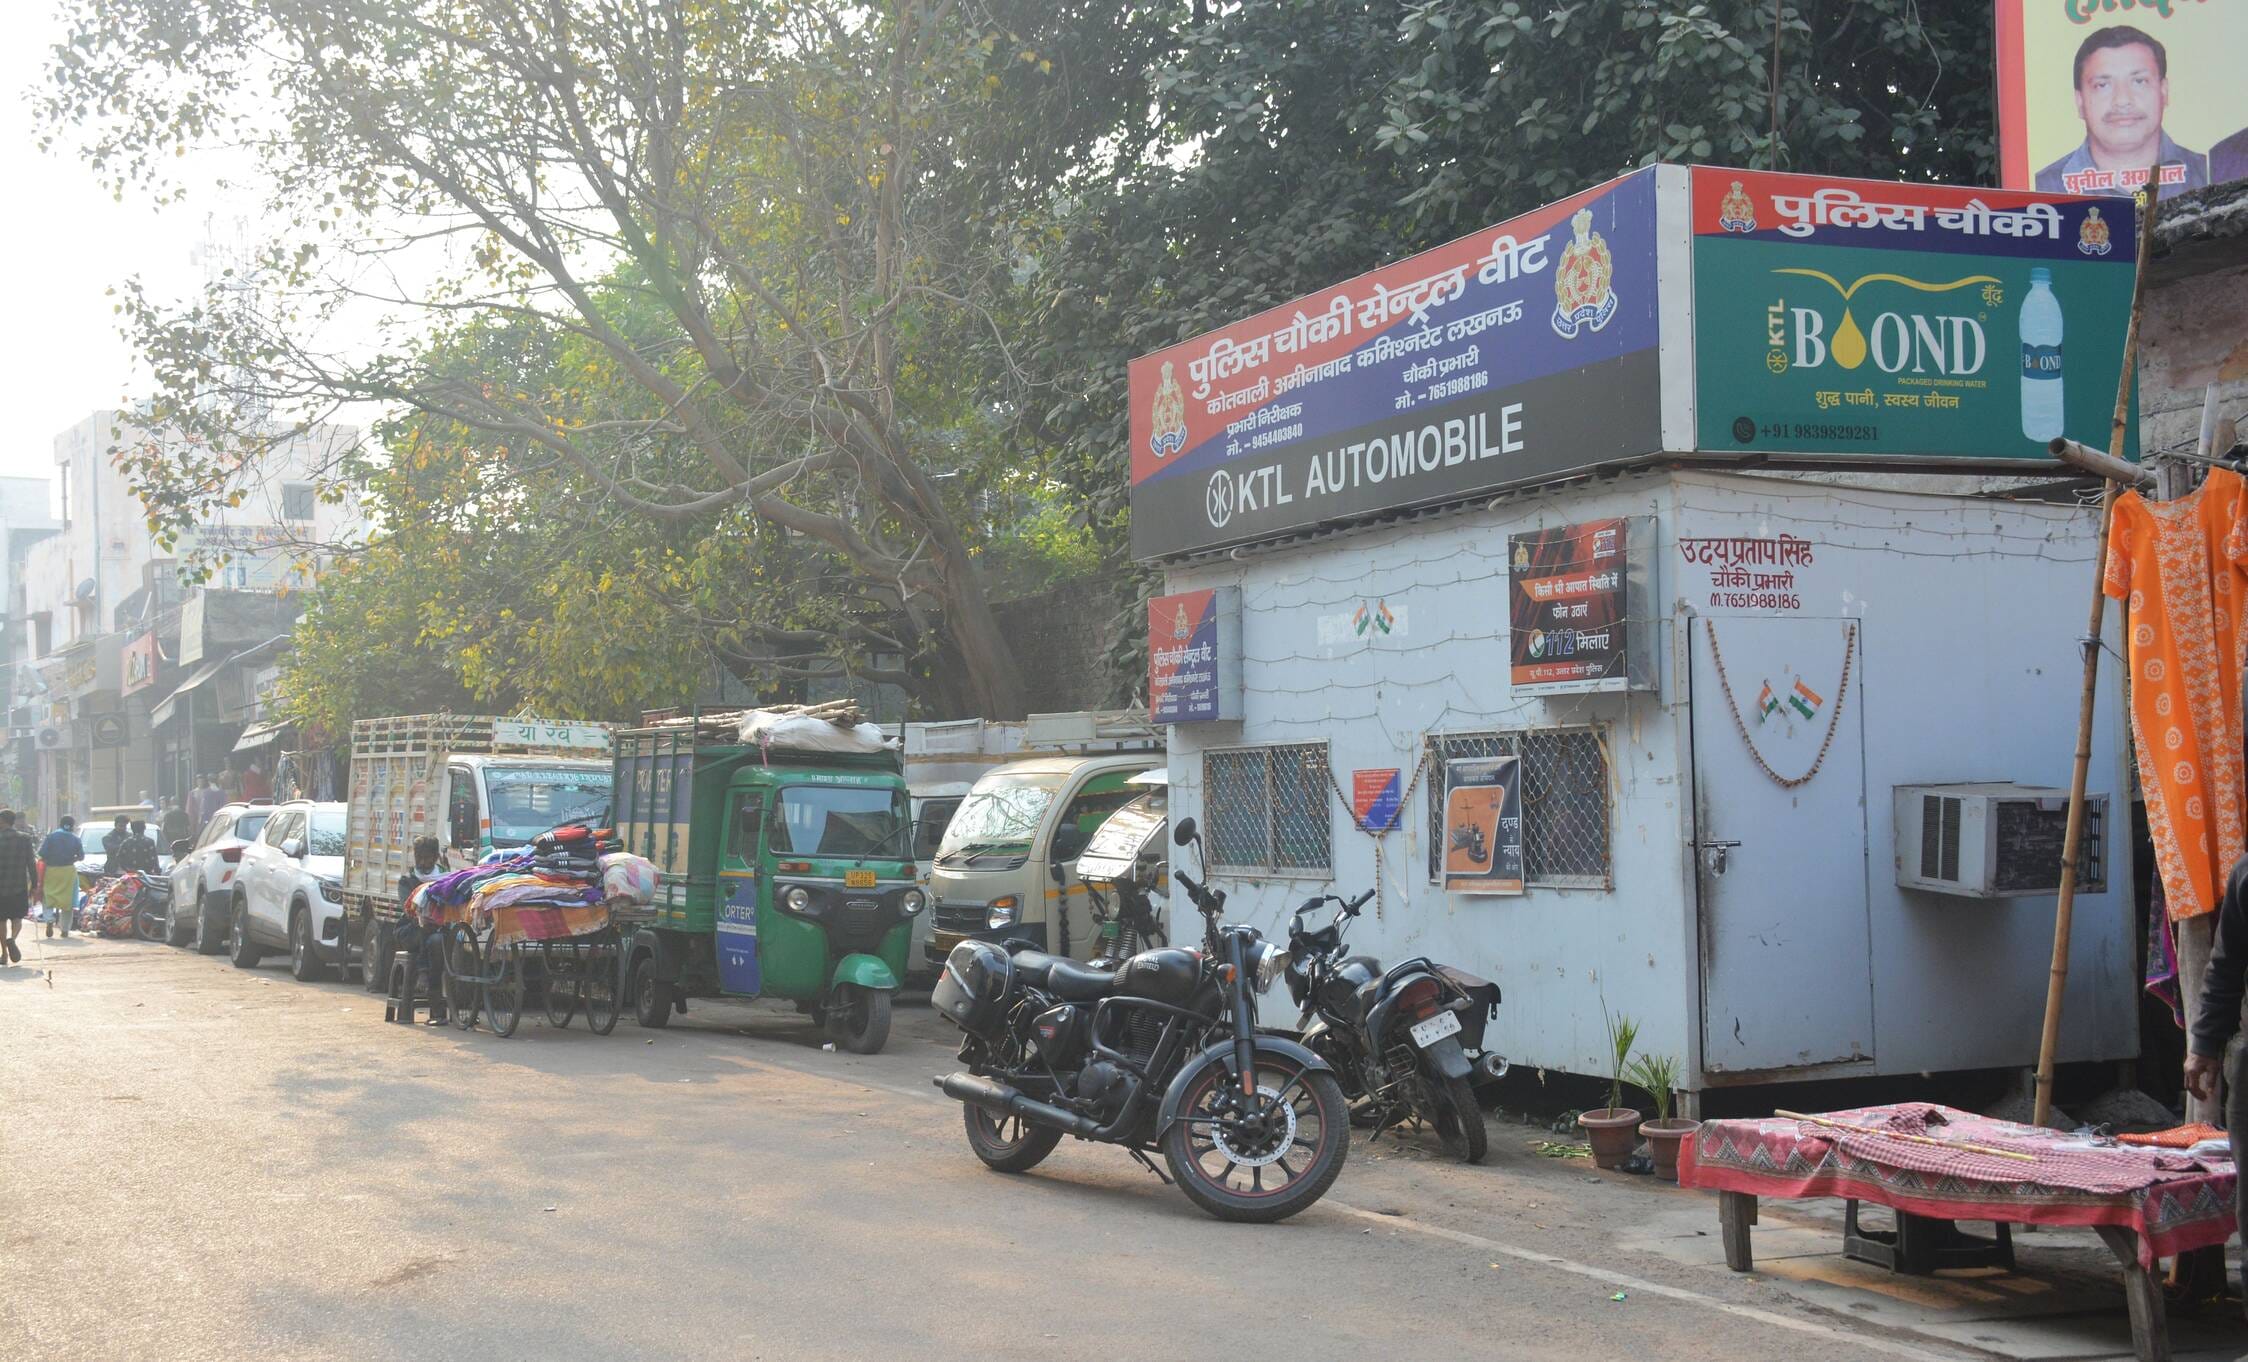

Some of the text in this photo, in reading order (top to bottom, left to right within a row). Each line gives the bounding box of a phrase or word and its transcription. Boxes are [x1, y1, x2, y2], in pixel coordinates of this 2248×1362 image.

[2065, 166, 2185, 194] सुनील अग्राल
[1770, 188, 2064, 240] पुलिस चौकी
[1188, 334, 1271, 400] पुलिस
[1273, 295, 1354, 354] चौकी
[1357, 263, 1469, 328] सेन्ट्रल
[1768, 298, 1785, 346] KTL
[1207, 300, 1524, 415] कोतवाली अमीनाबाद कमिश्नरेट लखनऊ
[1402, 345, 1479, 383] चौकी प्रभारी
[1897, 377, 1932, 387] PACKAGED
[1965, 380, 1987, 389] WATER
[1815, 390, 1840, 409] शुद्ध
[1883, 393, 1919, 409] स्वस्थ
[1924, 391, 1960, 409] जीवन
[1226, 402, 1303, 439] प्रभारी निरीक्षक
[1760, 424, 1789, 439] +91
[1238, 402, 1524, 514] KTL AUTOMOBILE
[1679, 533, 1814, 567] उदय प्रताप सिंह
[1535, 572, 1619, 598] किसी भी आपात स्थिति में
[1710, 565, 1794, 591] चौकी प्रभारी
[1552, 603, 1568, 619] फोन
[1545, 628, 1610, 656] 112 मिलाएं
[518, 726, 537, 741] या
[722, 905, 752, 920] ORTER
